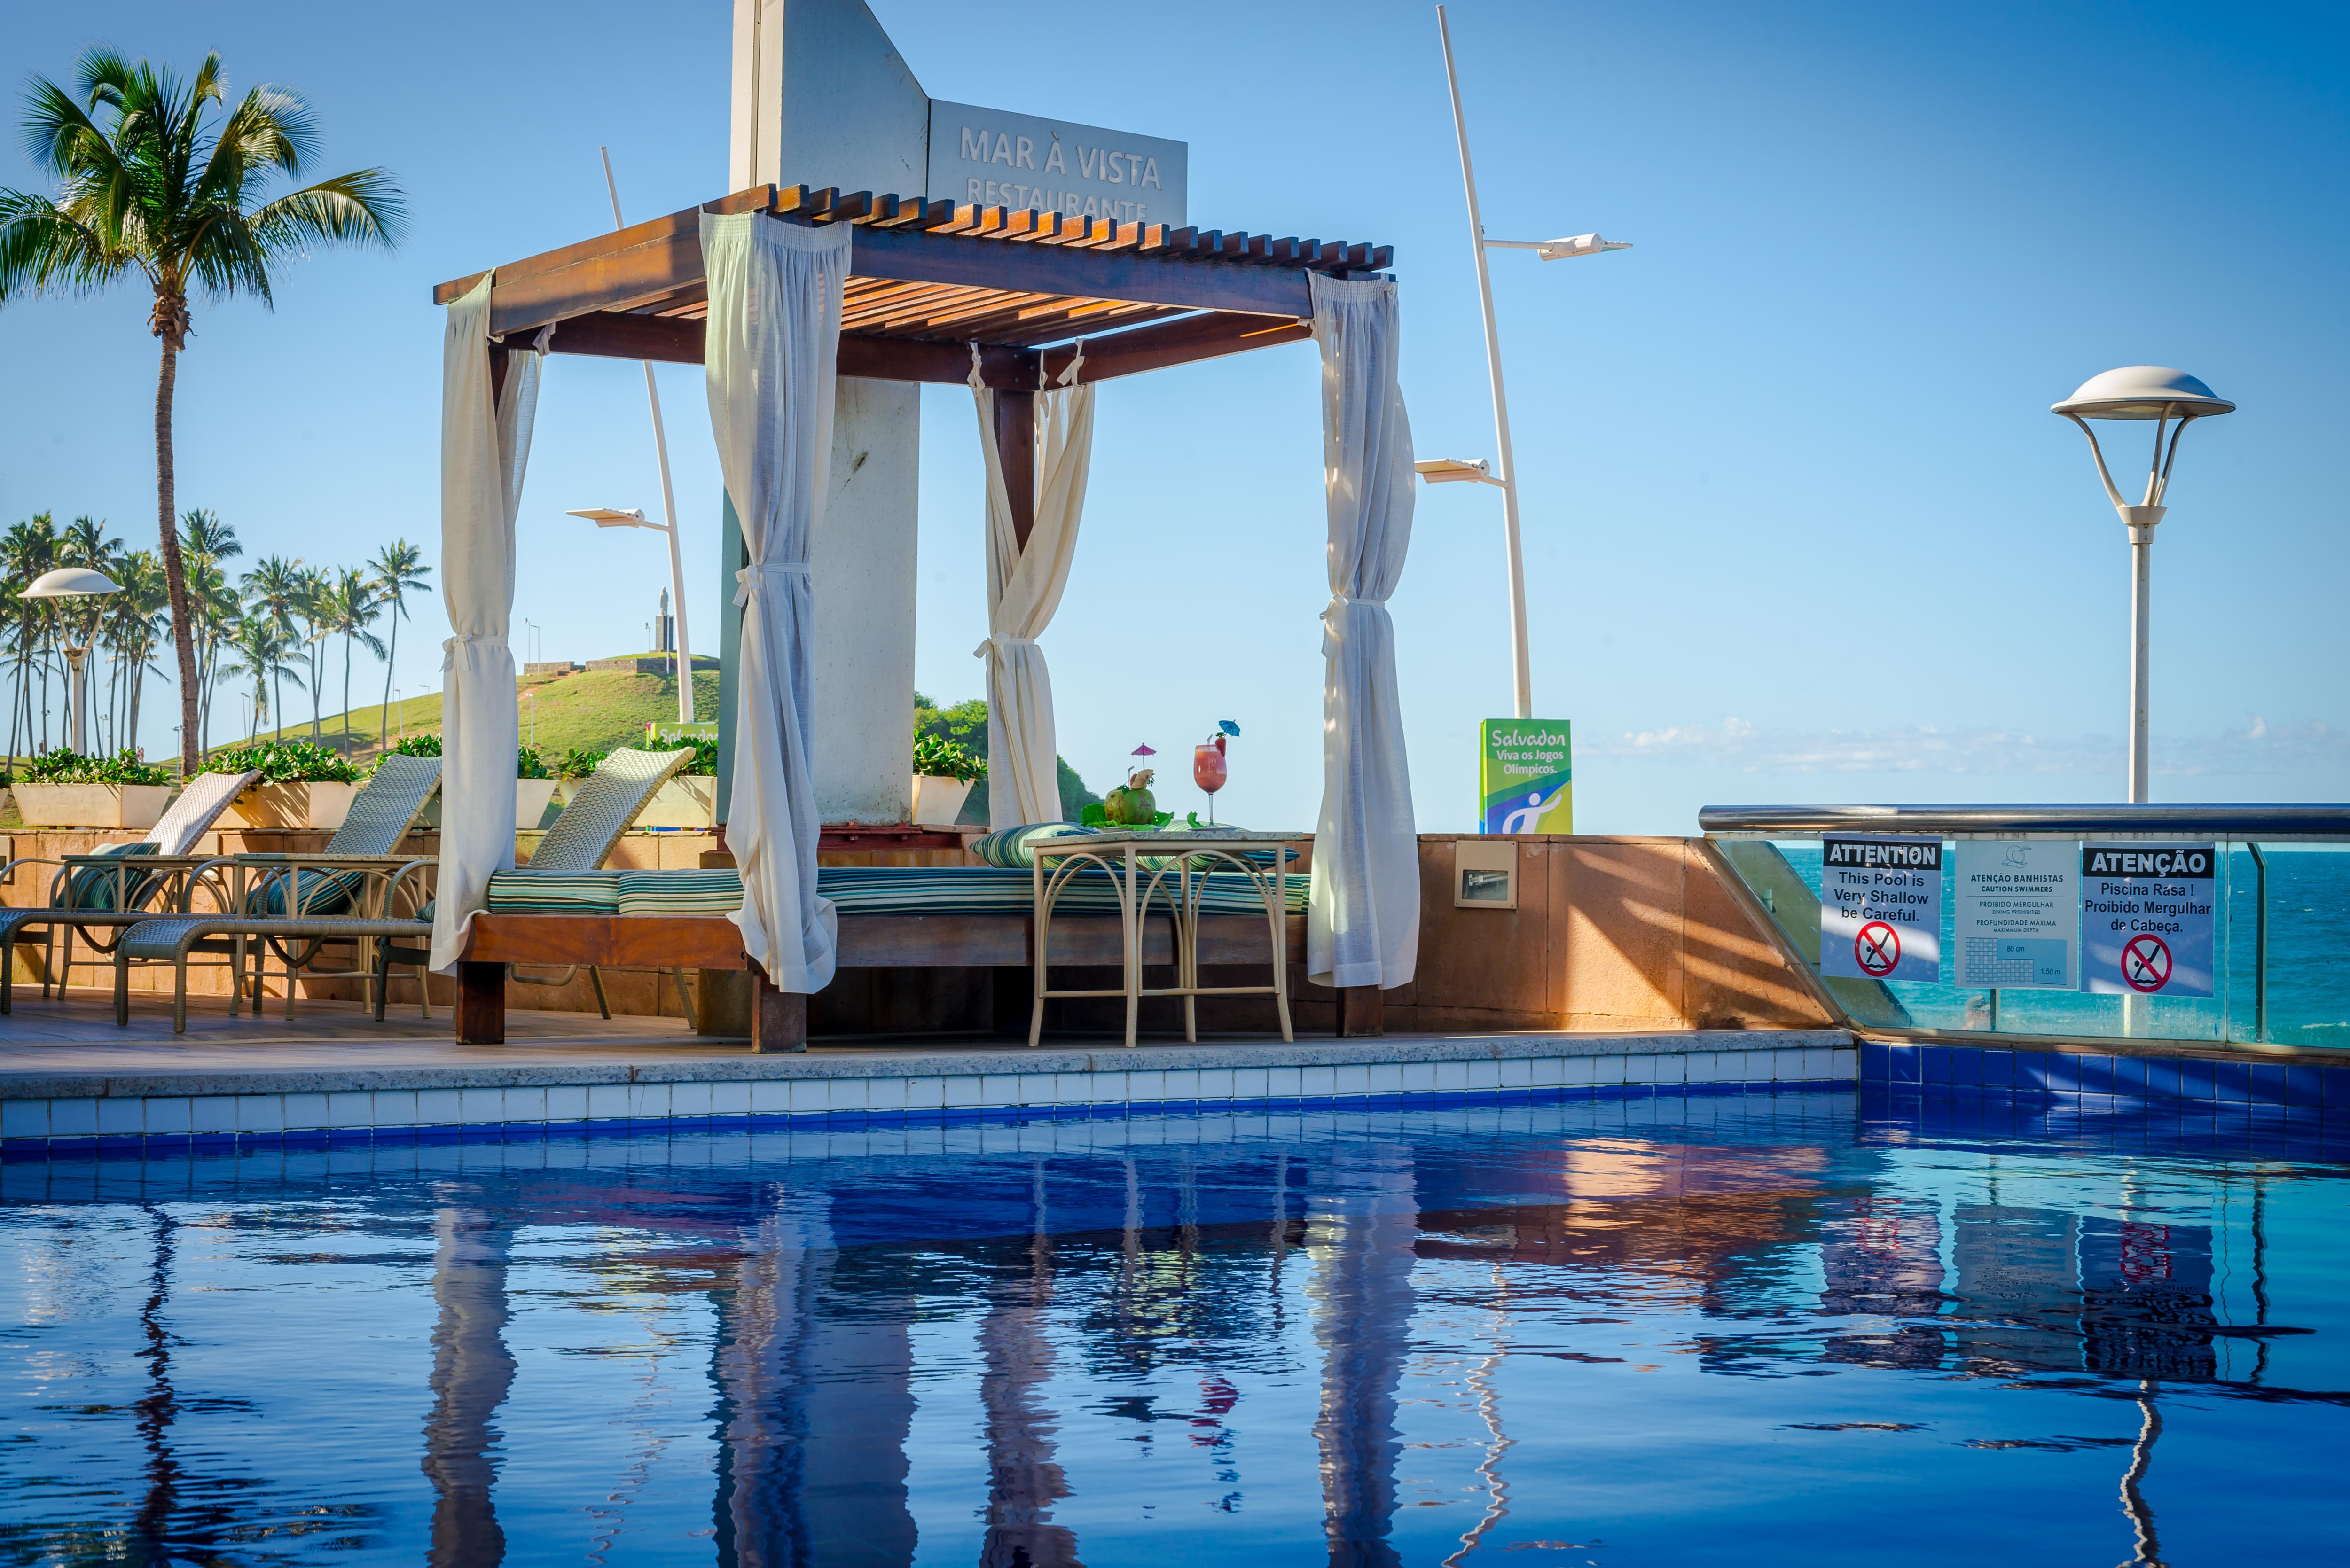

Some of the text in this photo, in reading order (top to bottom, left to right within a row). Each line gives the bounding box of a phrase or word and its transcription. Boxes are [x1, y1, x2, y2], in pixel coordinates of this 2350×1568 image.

[961, 126, 1162, 190] MAR À VISTA
[967, 177, 1148, 223] RESTAURANTE
[1492, 729, 1565, 747] Salvador
[1496, 750, 1519, 760] Viva
[1535, 750, 1564, 763] Jogos
[1504, 764, 1557, 777] Olímpicos.
[1830, 844, 1935, 865] ATTENTION
[2092, 850, 2206, 877] ATENÇÃO
[1839, 872, 1924, 887] This Pool is
[1971, 873, 2011, 883] ATENÇÃO
[1834, 889, 1929, 905] Very Shallow
[2101, 882, 2148, 895] Piscina
[2153, 883, 2186, 896] Rasa
[1841, 906, 1920, 921] be Careful.
[2085, 900, 2211, 917] Proibido Mergulhar
[2111, 919, 2183, 935] de Cabeça.
